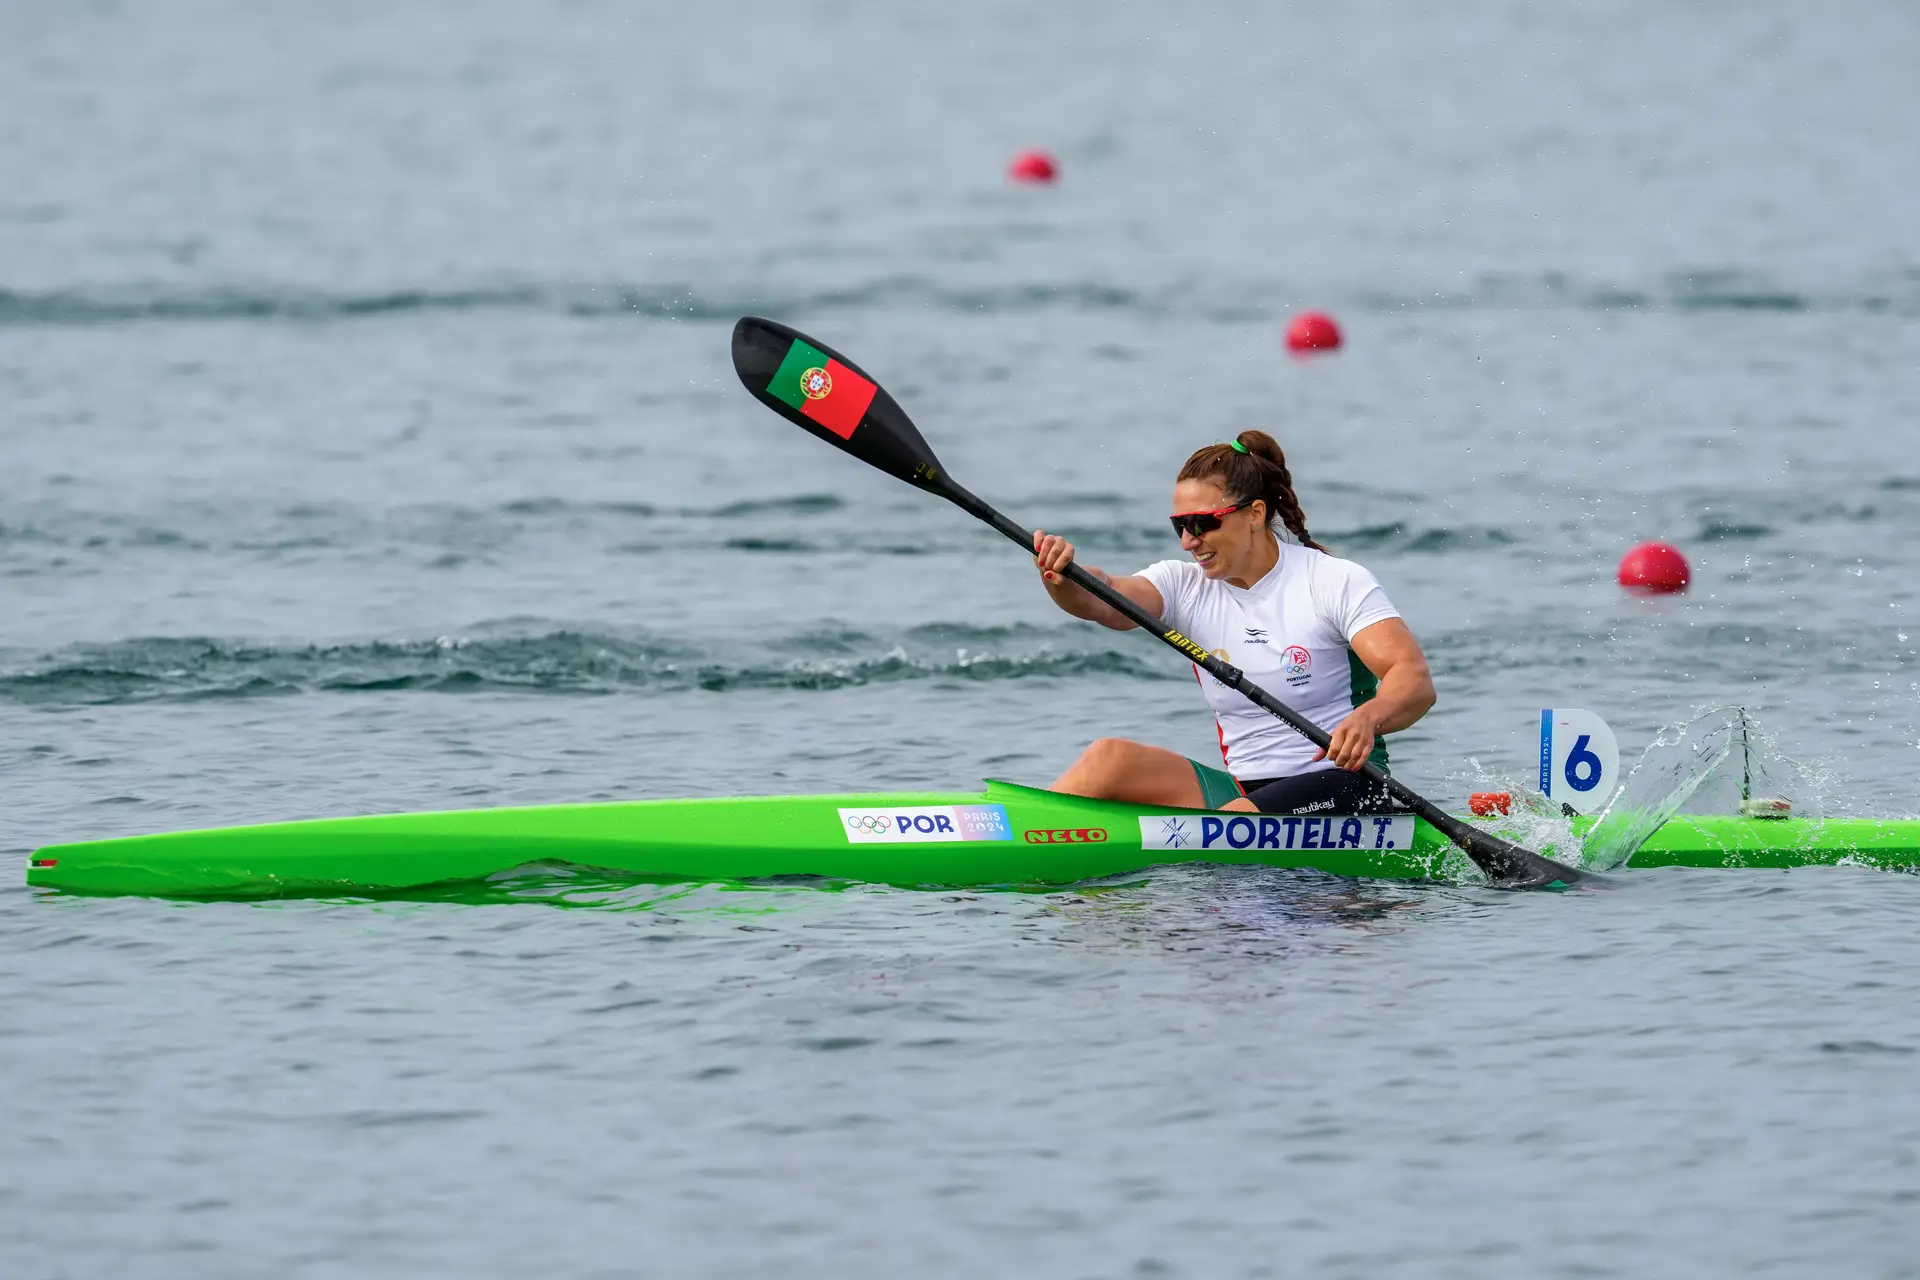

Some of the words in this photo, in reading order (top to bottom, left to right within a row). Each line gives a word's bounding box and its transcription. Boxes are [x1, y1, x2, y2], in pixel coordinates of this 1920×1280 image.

[1286, 673, 1313, 682] PORTUGAL
[1565, 735, 1603, 792] 6
[1292, 797, 1336, 815] nautikay
[963, 811, 1001, 821] PARIS
[895, 815, 955, 834] POR
[967, 822, 1004, 832] 2024
[1201, 816, 1363, 849] PORTELA
[1372, 817, 1395, 849] T.
[1027, 829, 1106, 843] NELO
